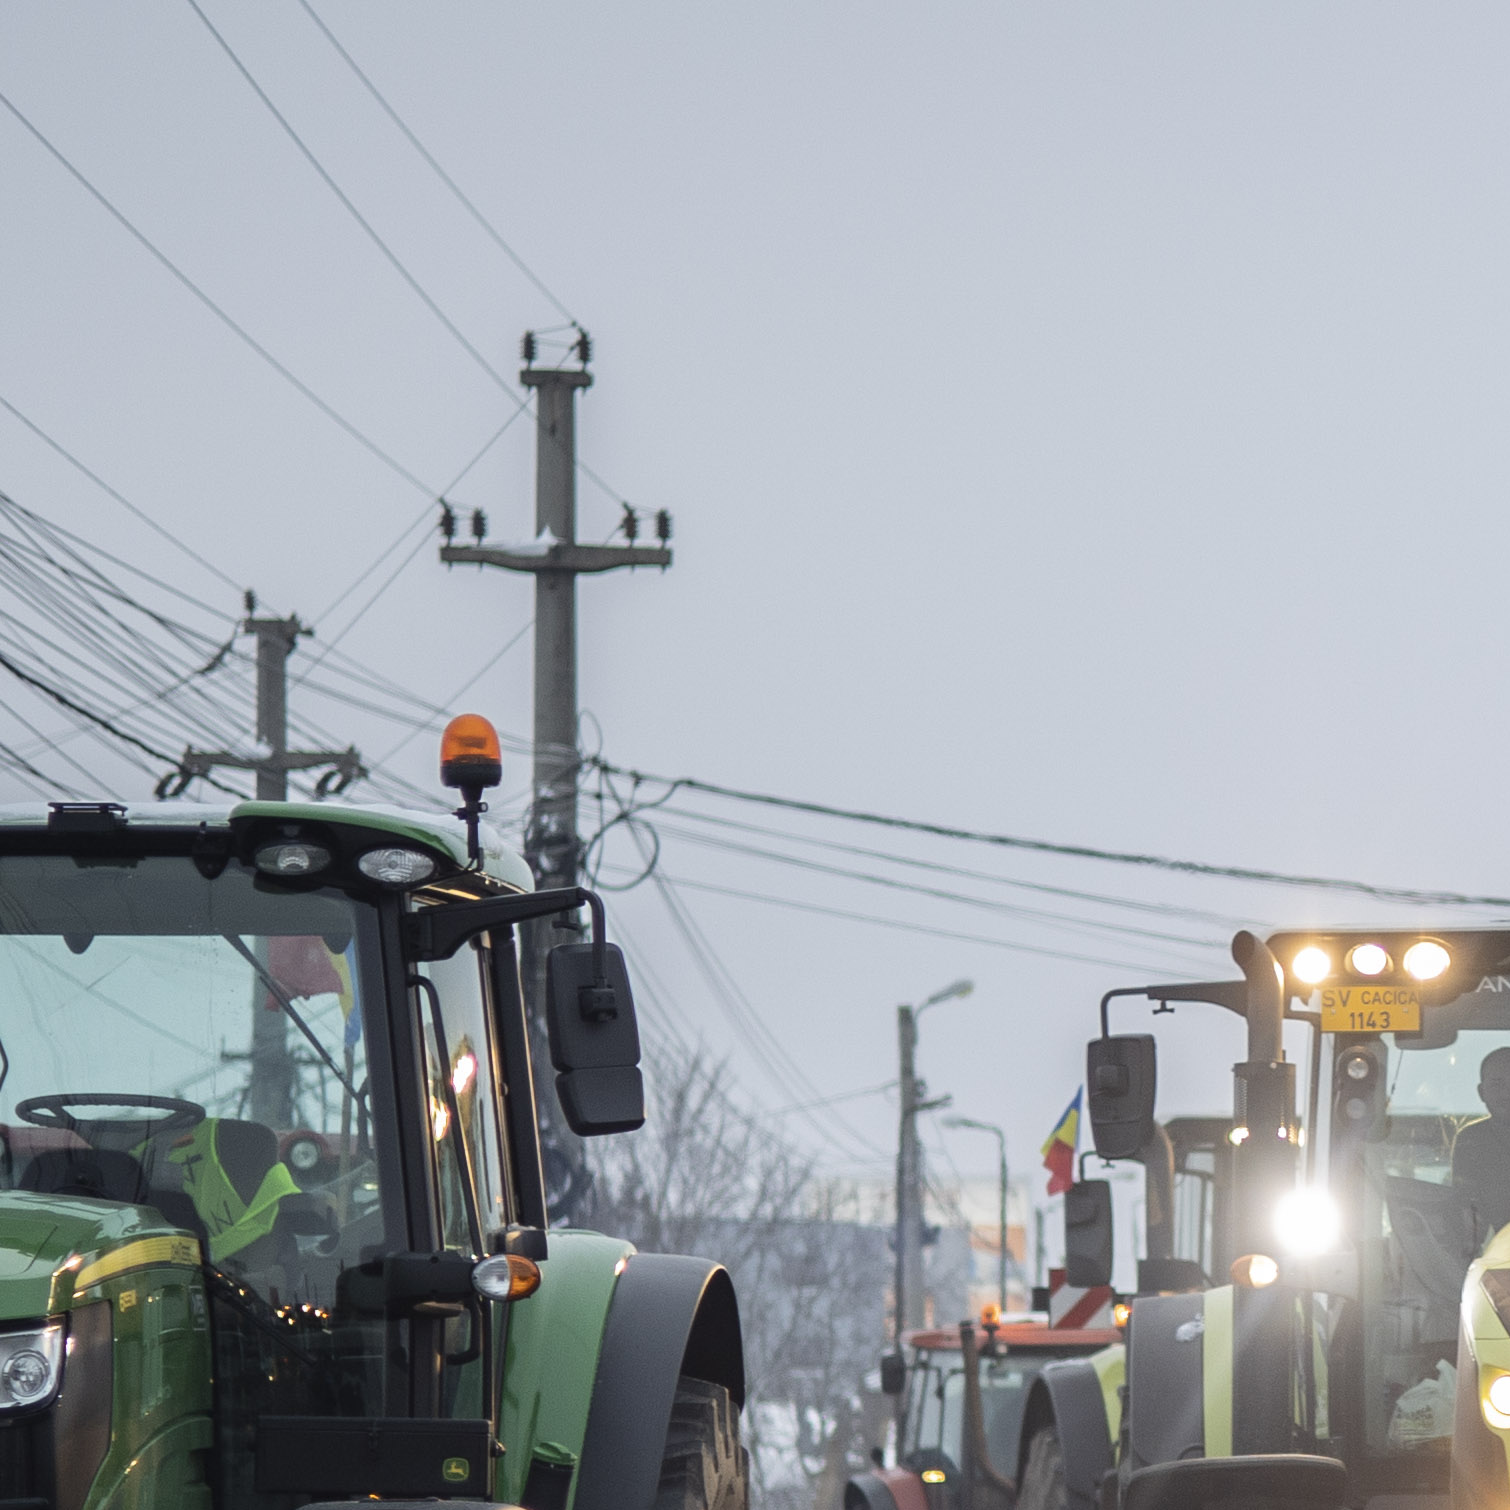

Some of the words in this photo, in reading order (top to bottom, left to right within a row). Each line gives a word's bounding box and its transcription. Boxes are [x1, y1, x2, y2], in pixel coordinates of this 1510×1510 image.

[1322, 990, 1351, 1008] SV
[1360, 989, 1420, 1006] CACICA
[1349, 1011, 1391, 1029] 1143
